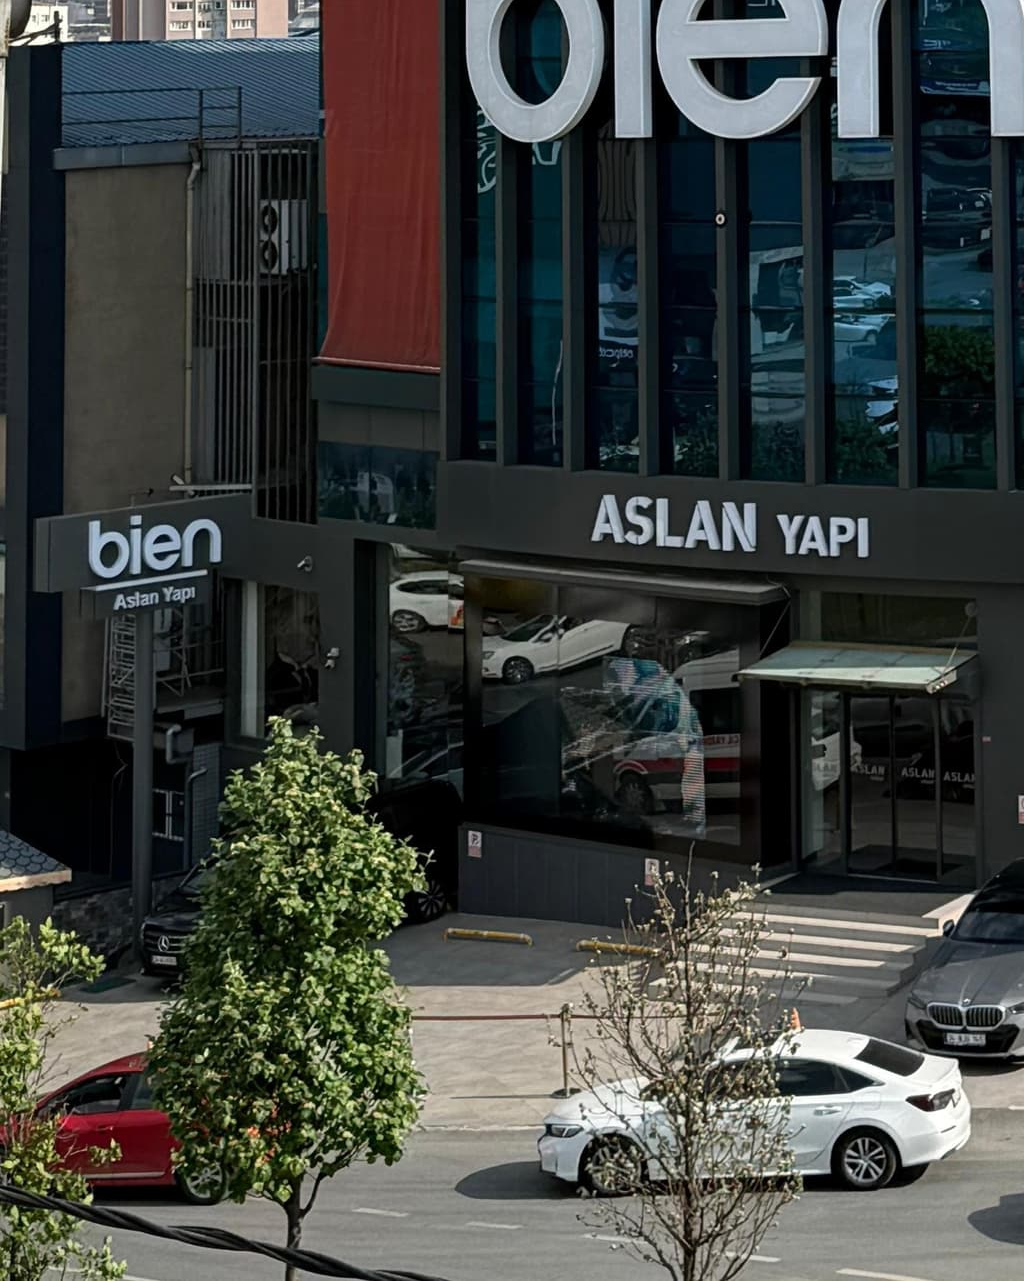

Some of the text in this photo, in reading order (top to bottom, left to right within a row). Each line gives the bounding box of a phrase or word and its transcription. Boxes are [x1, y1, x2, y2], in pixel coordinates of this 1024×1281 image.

[88, 515, 222, 579] bien
[591, 494, 870, 558] ASLAN YAPI
[113, 586, 196, 611] Aslan Yapı
